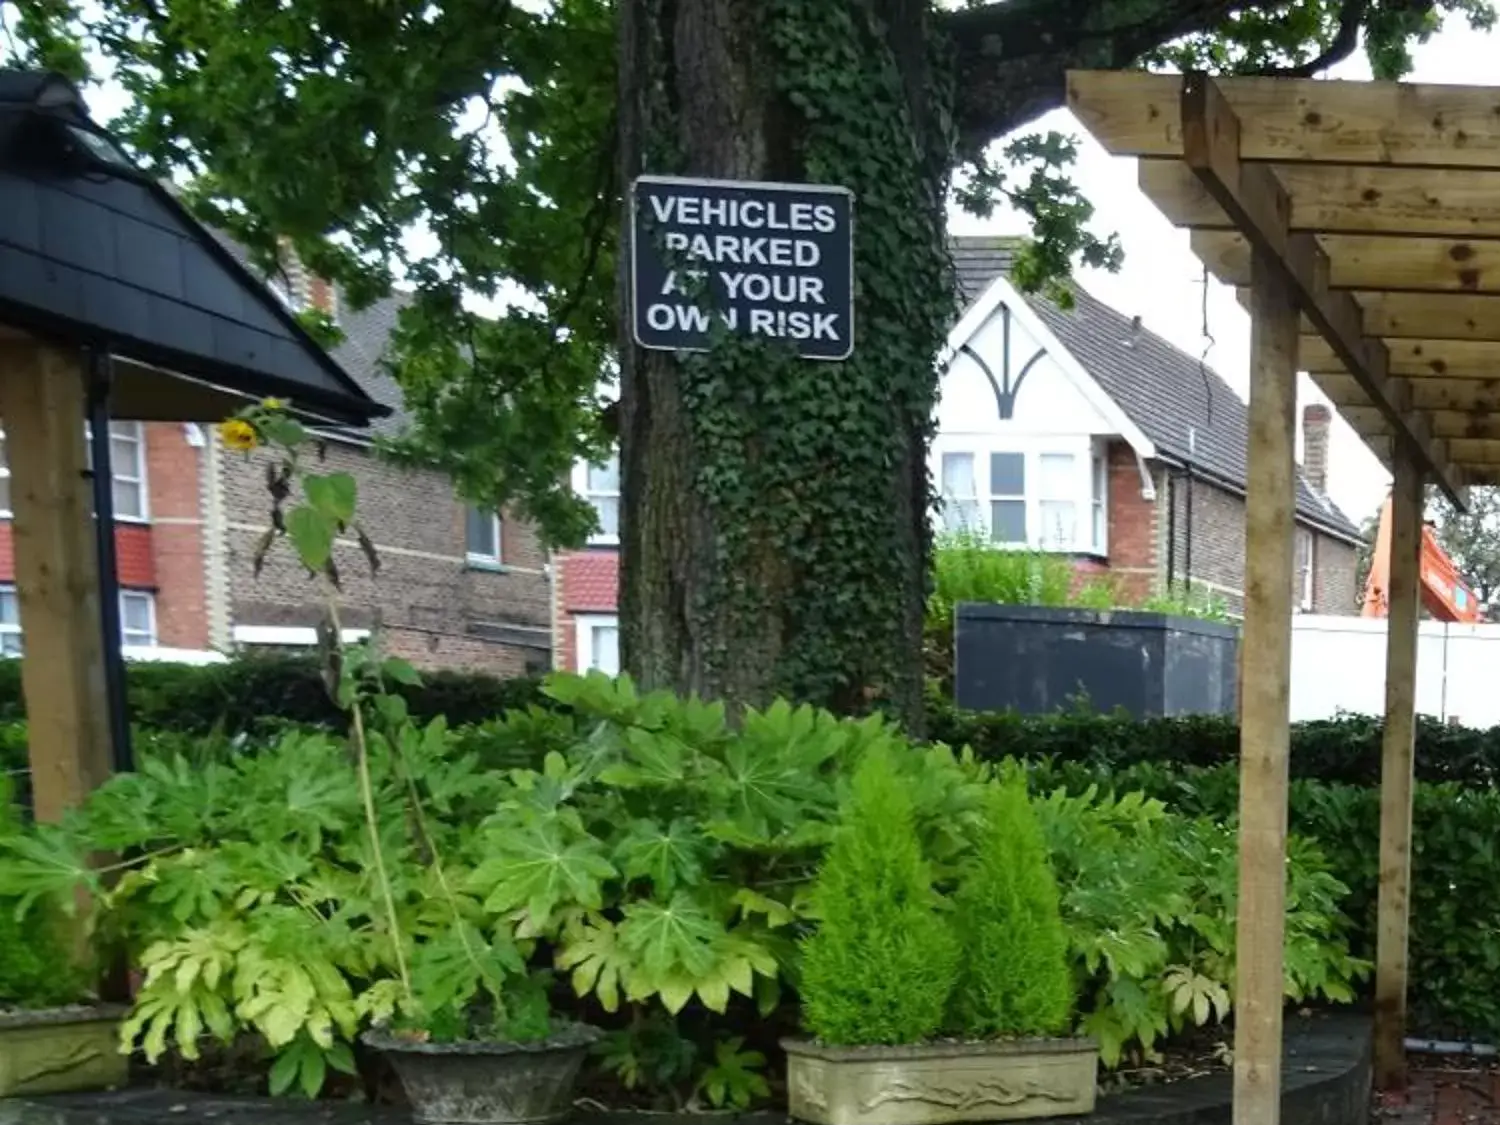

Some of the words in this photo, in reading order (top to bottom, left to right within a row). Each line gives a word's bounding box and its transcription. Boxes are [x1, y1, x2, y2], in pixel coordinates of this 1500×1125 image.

[650, 195, 836, 232] VEHICLES
[665, 232, 821, 267] PARKED
[719, 271, 826, 304] YOUR
[750, 309, 840, 341] RISK
